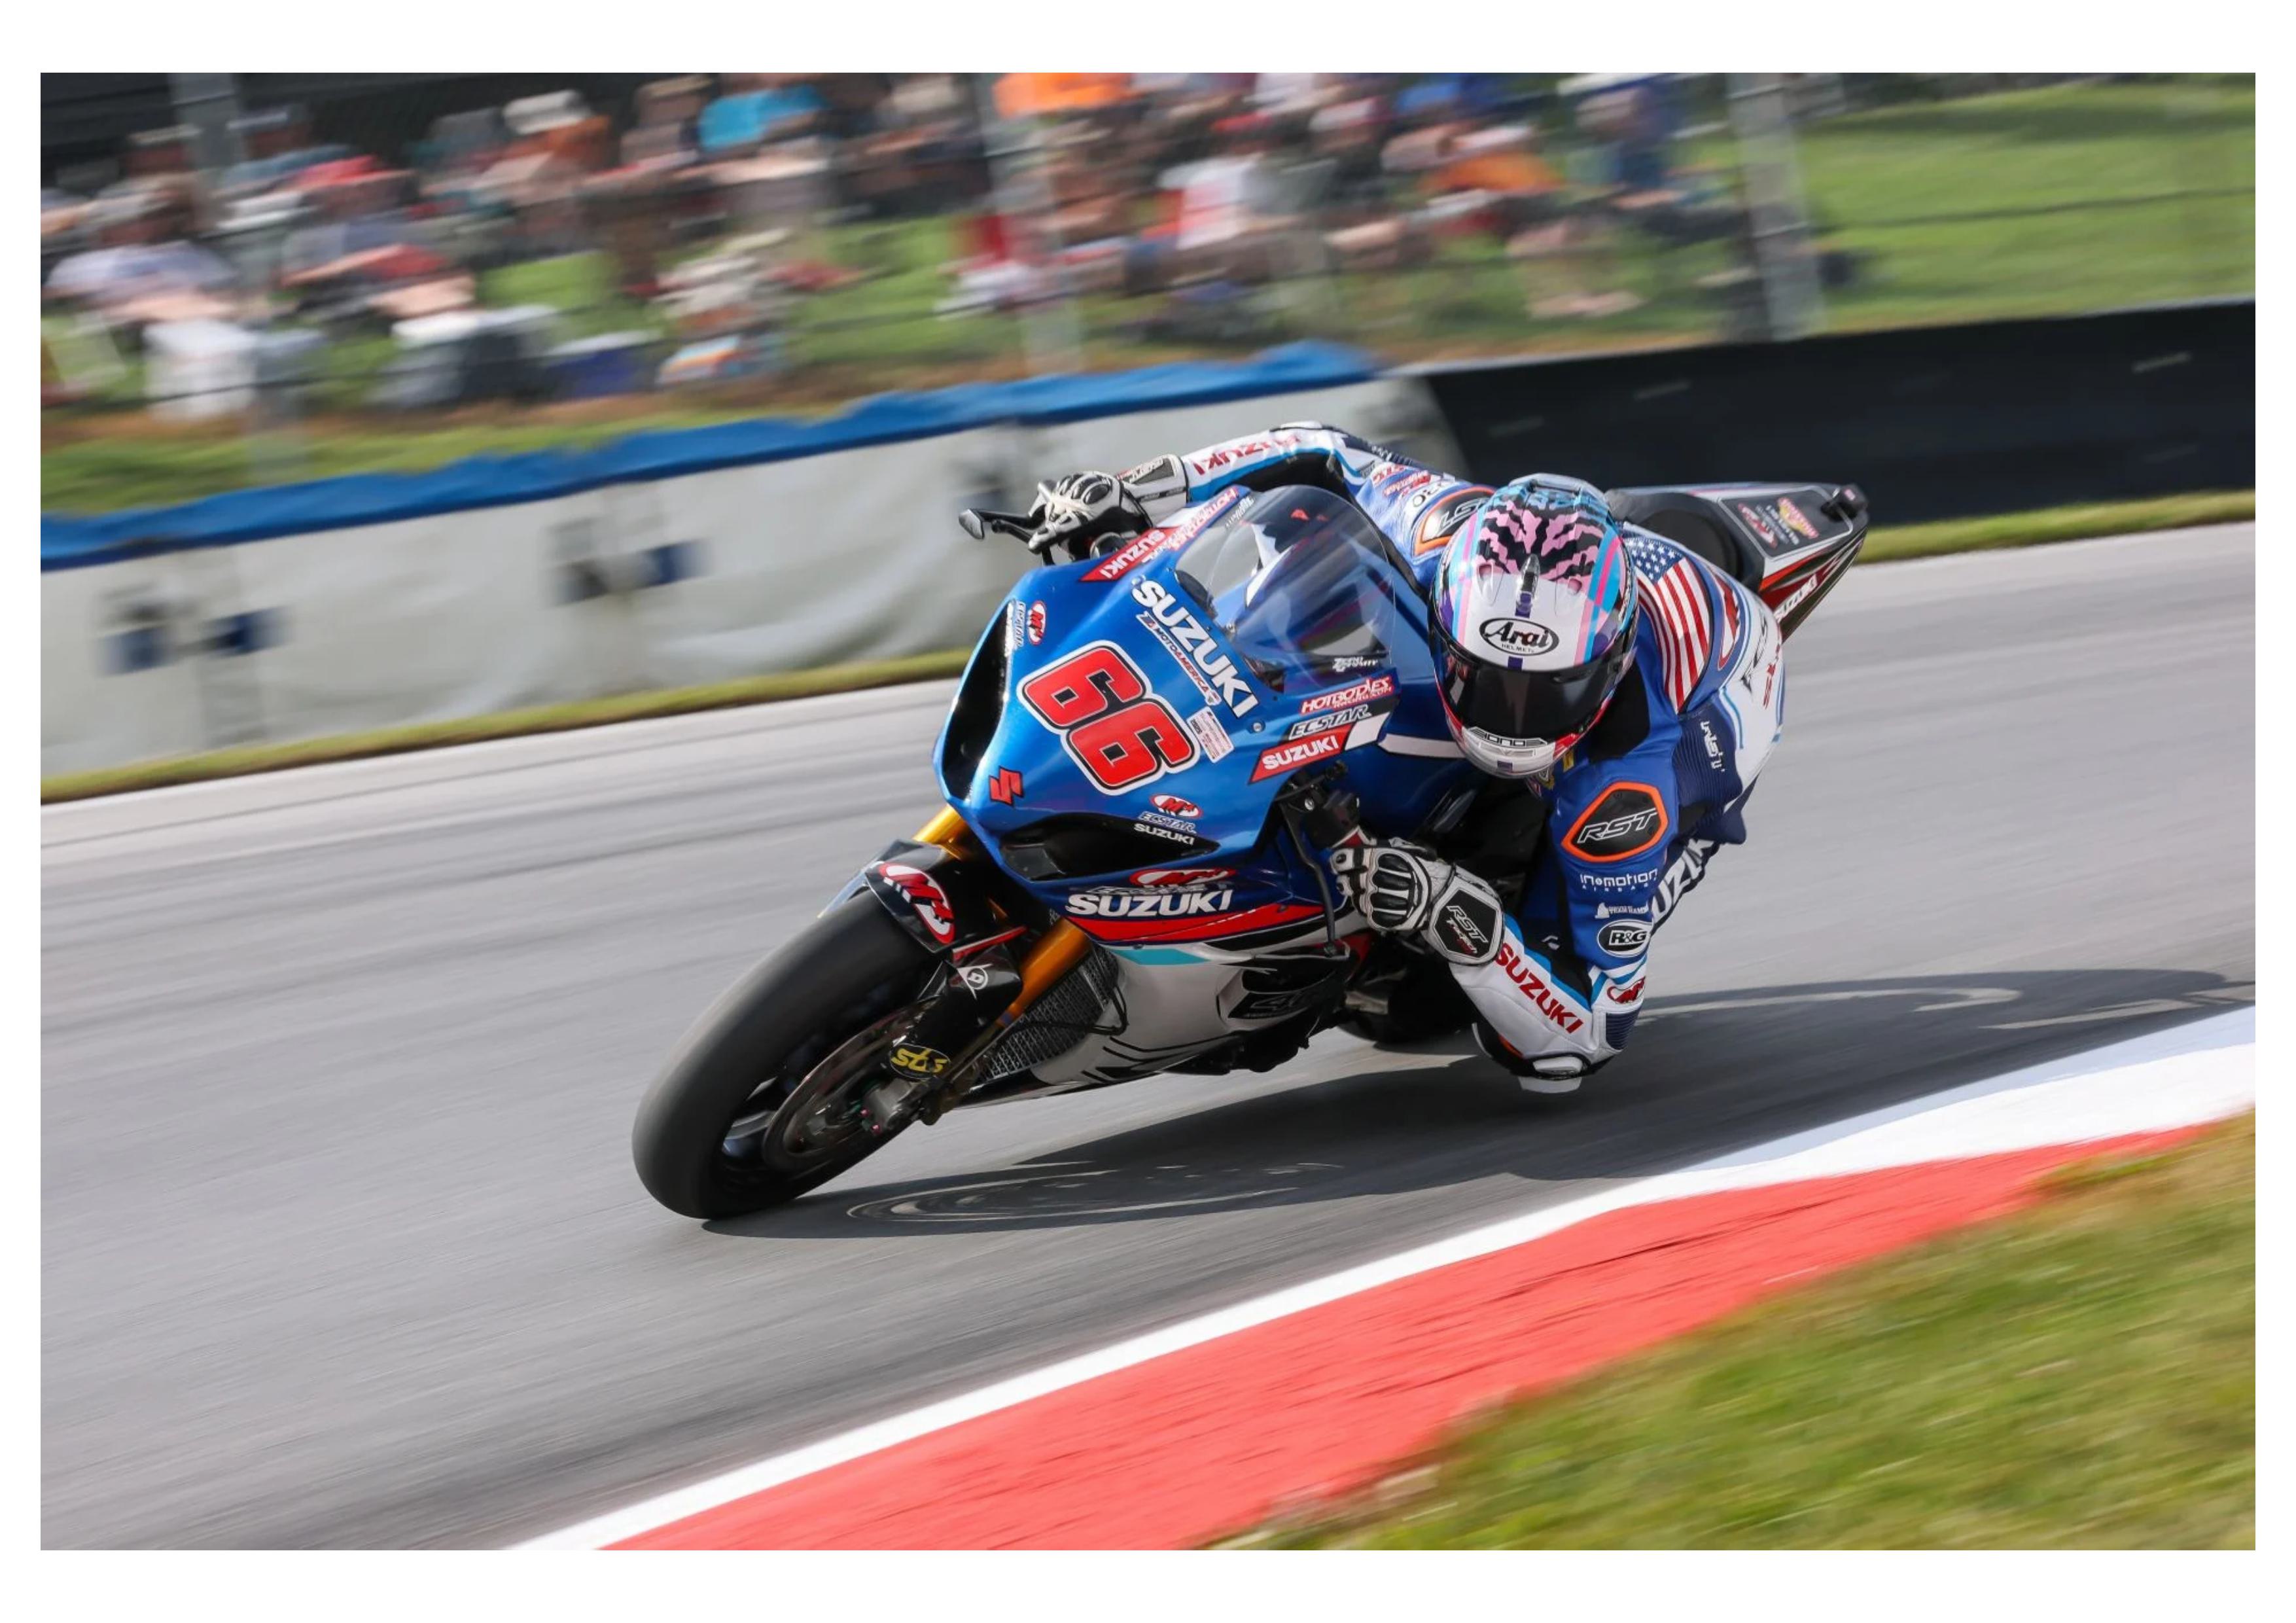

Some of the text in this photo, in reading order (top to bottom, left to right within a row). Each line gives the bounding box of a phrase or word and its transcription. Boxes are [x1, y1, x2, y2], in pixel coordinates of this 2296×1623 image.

[1099, 529, 1166, 579] SUZUKI
[1131, 580, 1259, 718] SUZUKI
[1483, 620, 1549, 648] Arai
[1153, 626, 1210, 694] MOTOAMERICA
[1019, 643, 1197, 793] 66
[1288, 704, 1373, 741] ECSTAR
[1262, 735, 1339, 770] SUZUKI
[1133, 823, 1195, 846] SUZUKI
[1576, 807, 1658, 844] RST
[1065, 889, 1233, 917] SUZUKI
[1445, 905, 1489, 943] RST
[1609, 930, 1649, 946] R&G
[1494, 942, 1584, 1034] SUZUKI
